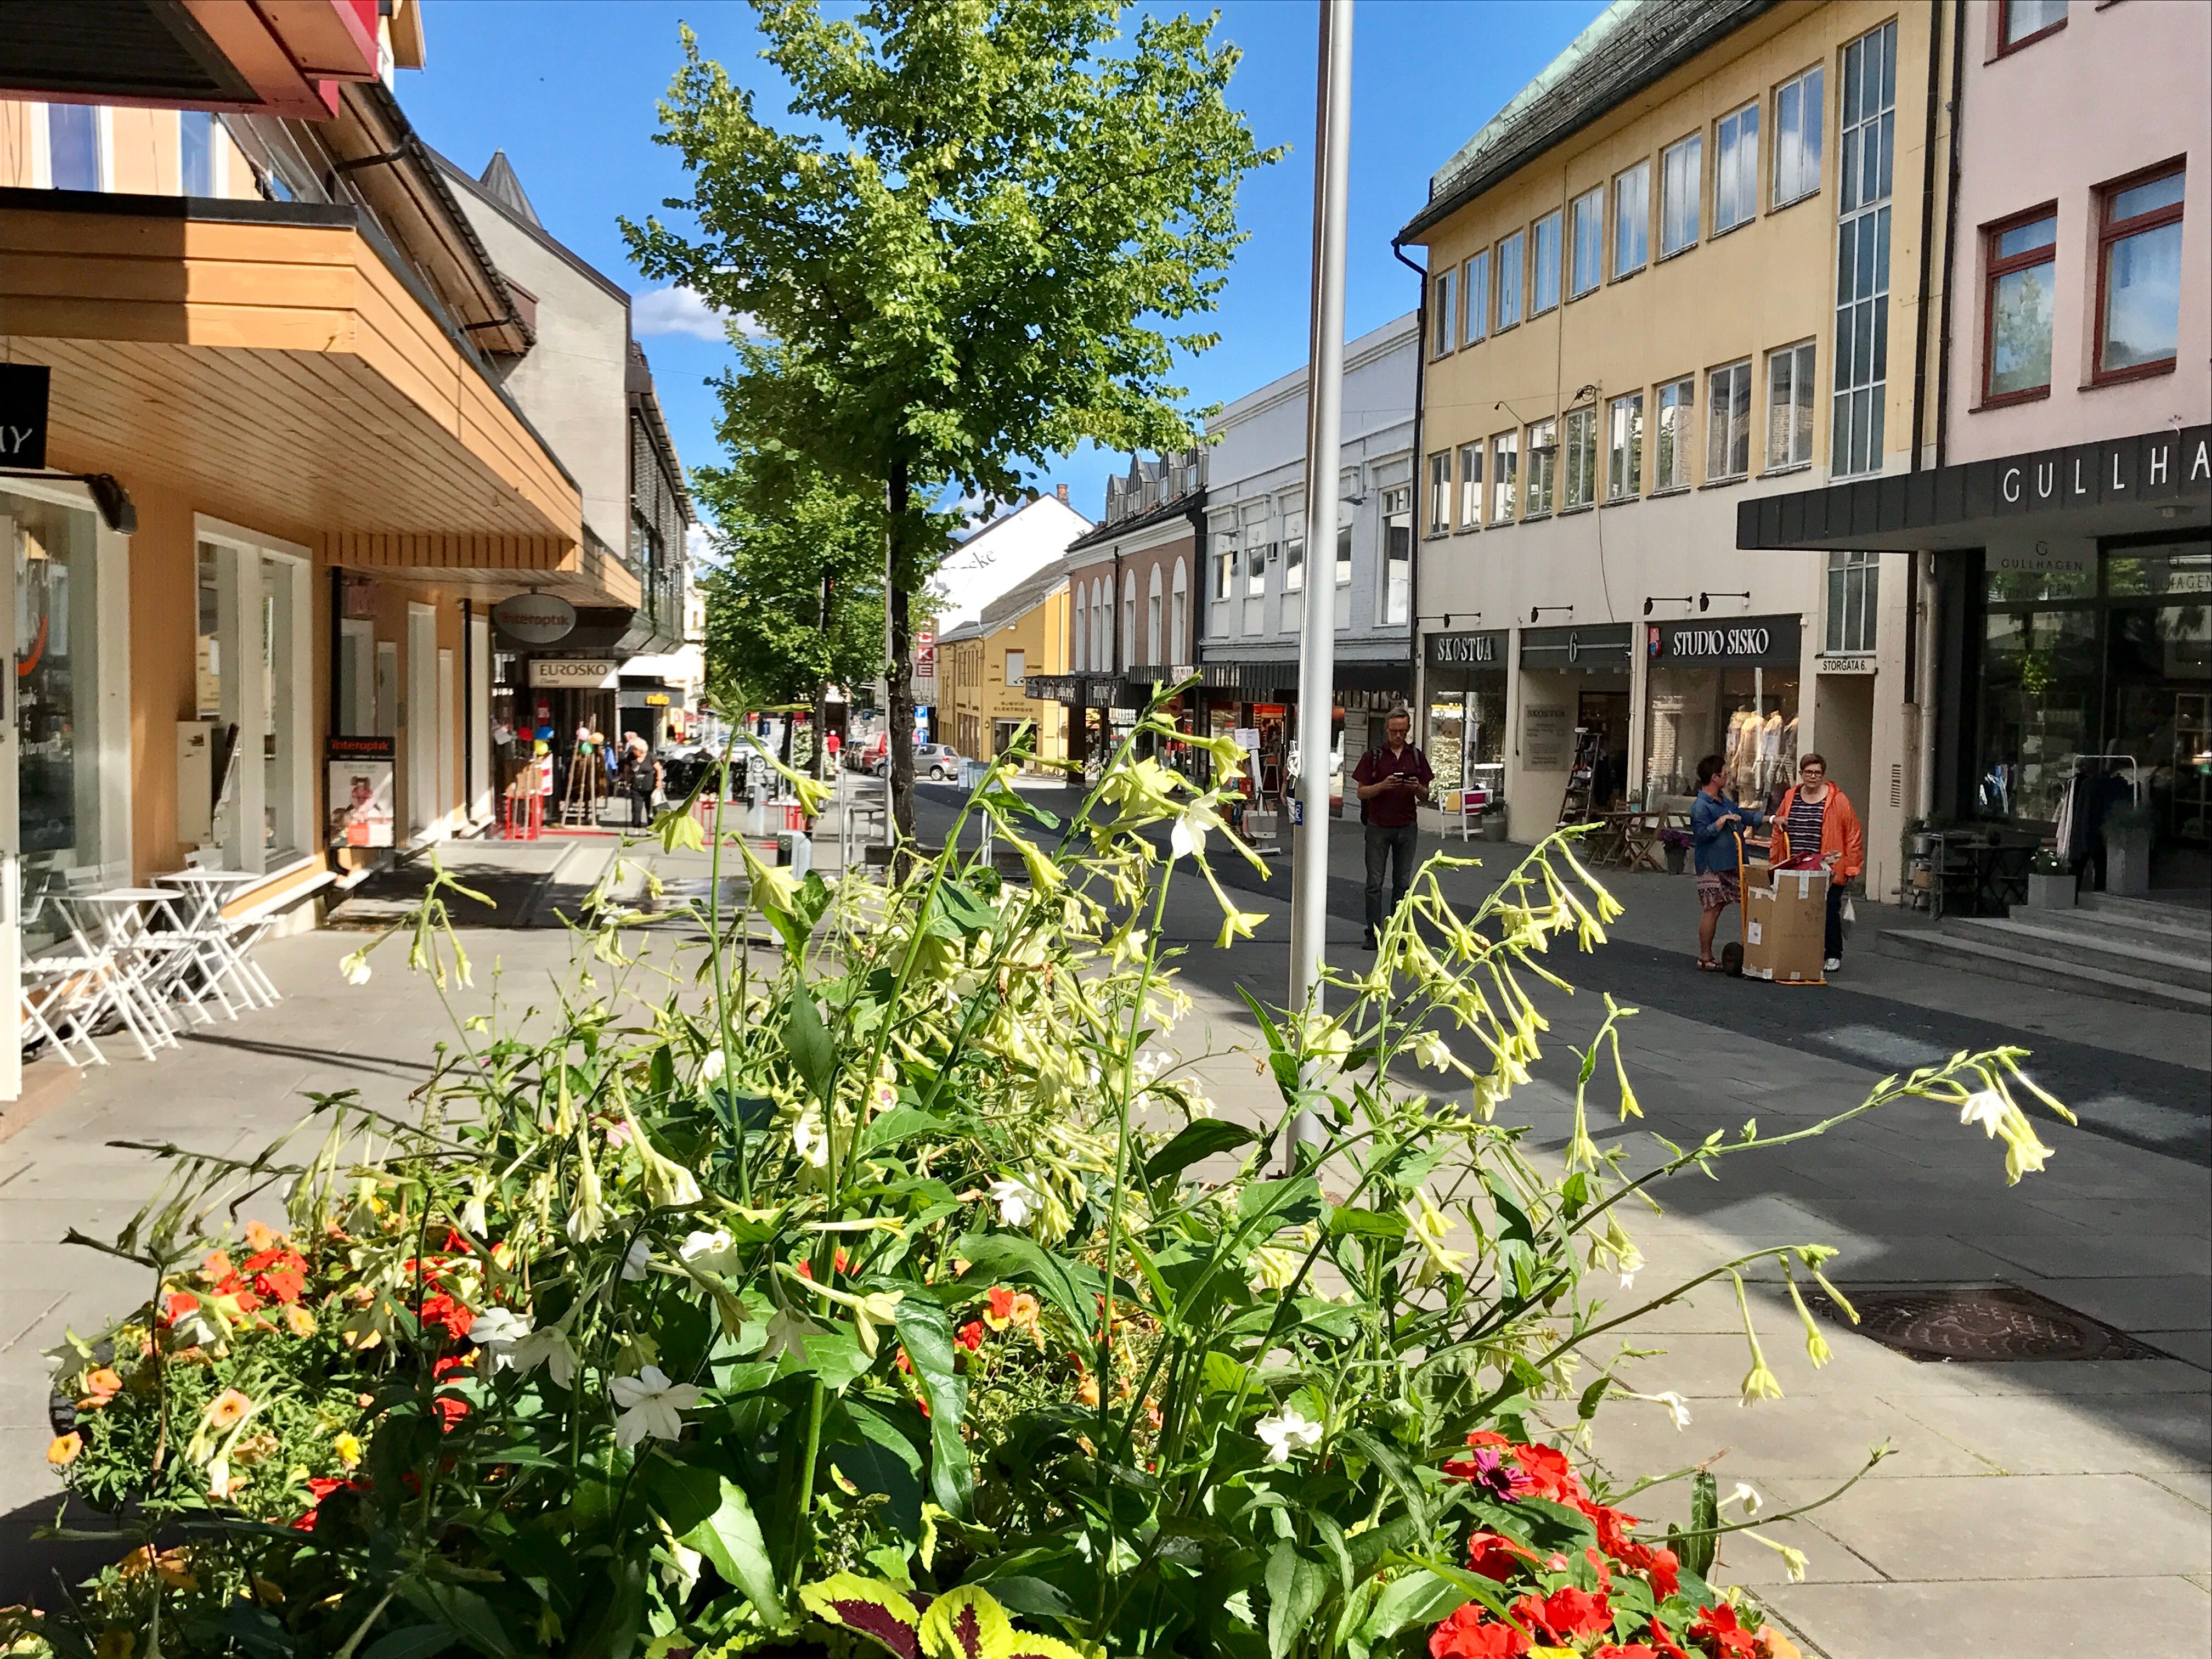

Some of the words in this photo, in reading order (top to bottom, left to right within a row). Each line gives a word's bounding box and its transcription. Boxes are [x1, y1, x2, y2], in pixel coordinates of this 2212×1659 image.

[2003, 441, 2211, 503] GULLHA
[2001, 558, 2083, 571] GULLHAGEN
[1437, 636, 1493, 661] SKOSTUA
[1569, 631, 1577, 663] 6
[1673, 630, 1724, 656] STUDIO
[1727, 628, 1769, 654] SISKO
[539, 664, 608, 676] EUROSKO
[1822, 660, 1859, 670] STORGATA
